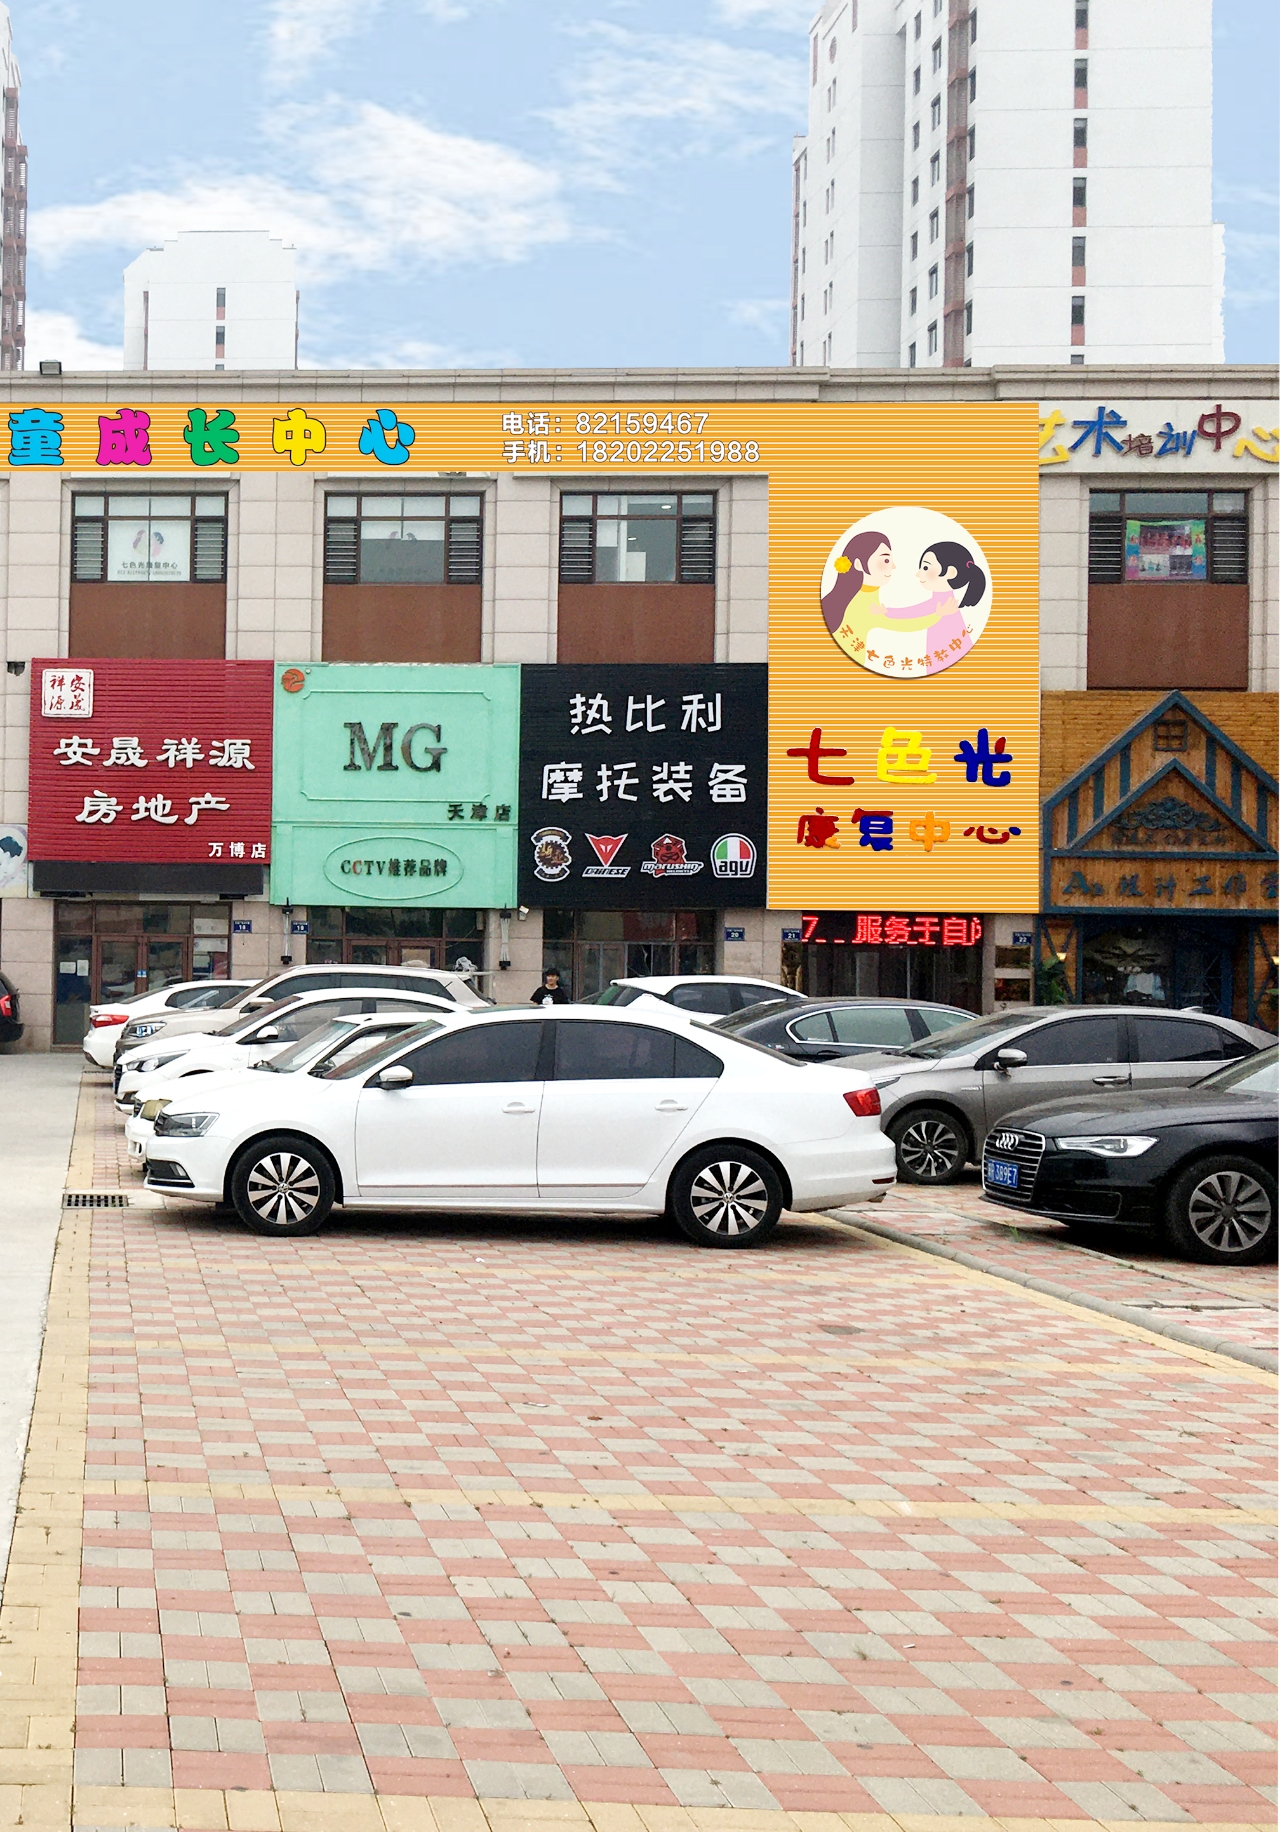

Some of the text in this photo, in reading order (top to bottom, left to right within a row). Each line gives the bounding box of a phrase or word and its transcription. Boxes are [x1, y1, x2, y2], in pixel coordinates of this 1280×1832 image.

[569, 693, 722, 735] 热比利
[53, 735, 256, 770] 安晟祥源
[343, 721, 448, 773] MG
[786, 726, 1013, 787] 七色光
[541, 761, 748, 804] 摩托装备
[75, 789, 231, 825] 房地产
[448, 804, 511, 821] 天津店
[797, 807, 1021, 852] 康复中心
[208, 842, 267, 859] 万博店
[341, 858, 448, 876] CCTV推荐品牌
[719, 860, 751, 877] agv
